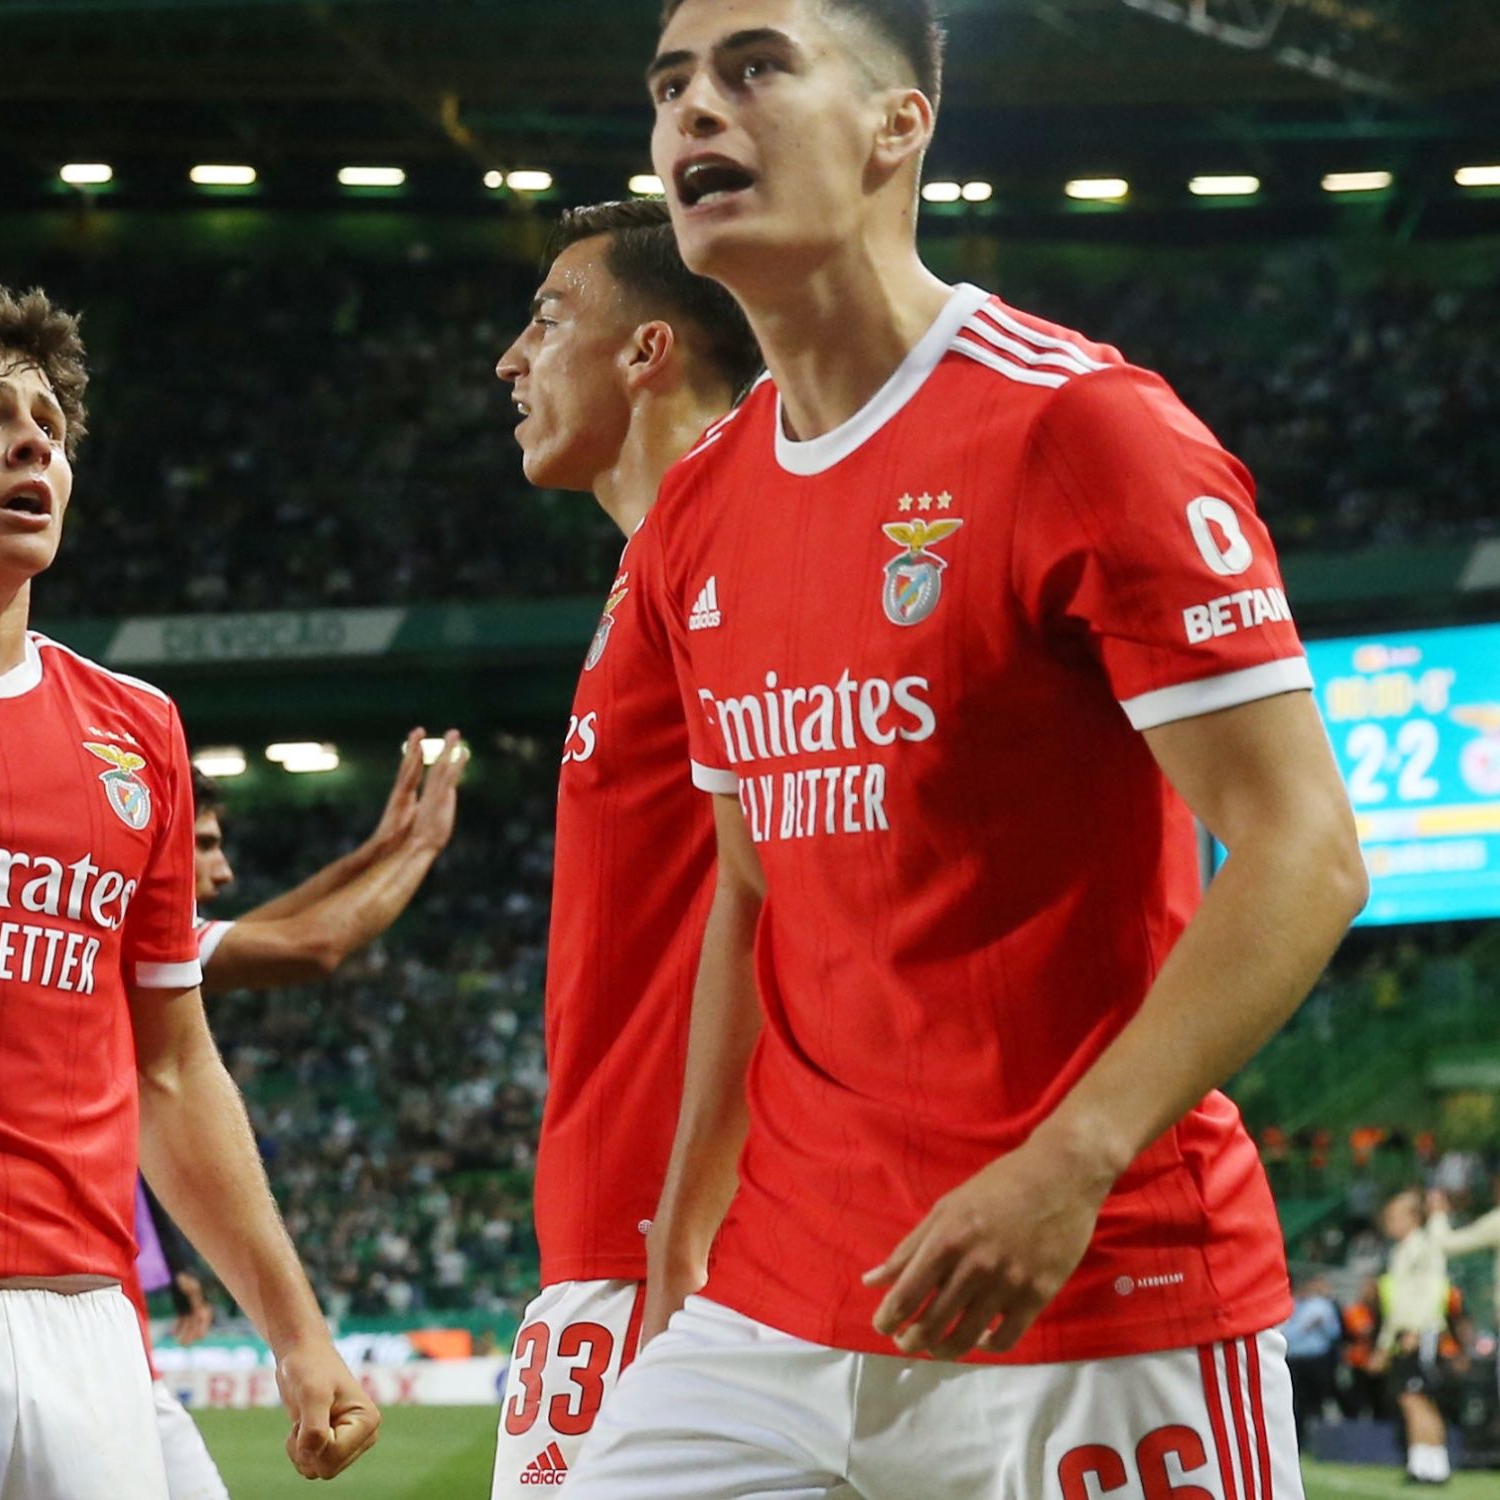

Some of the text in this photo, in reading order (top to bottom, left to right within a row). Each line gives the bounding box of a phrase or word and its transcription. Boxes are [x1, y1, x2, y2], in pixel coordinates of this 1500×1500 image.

[1182, 587, 1292, 645] BETAN
[504, 1321, 615, 1436] 33
[520, 1469, 567, 1485] adida
